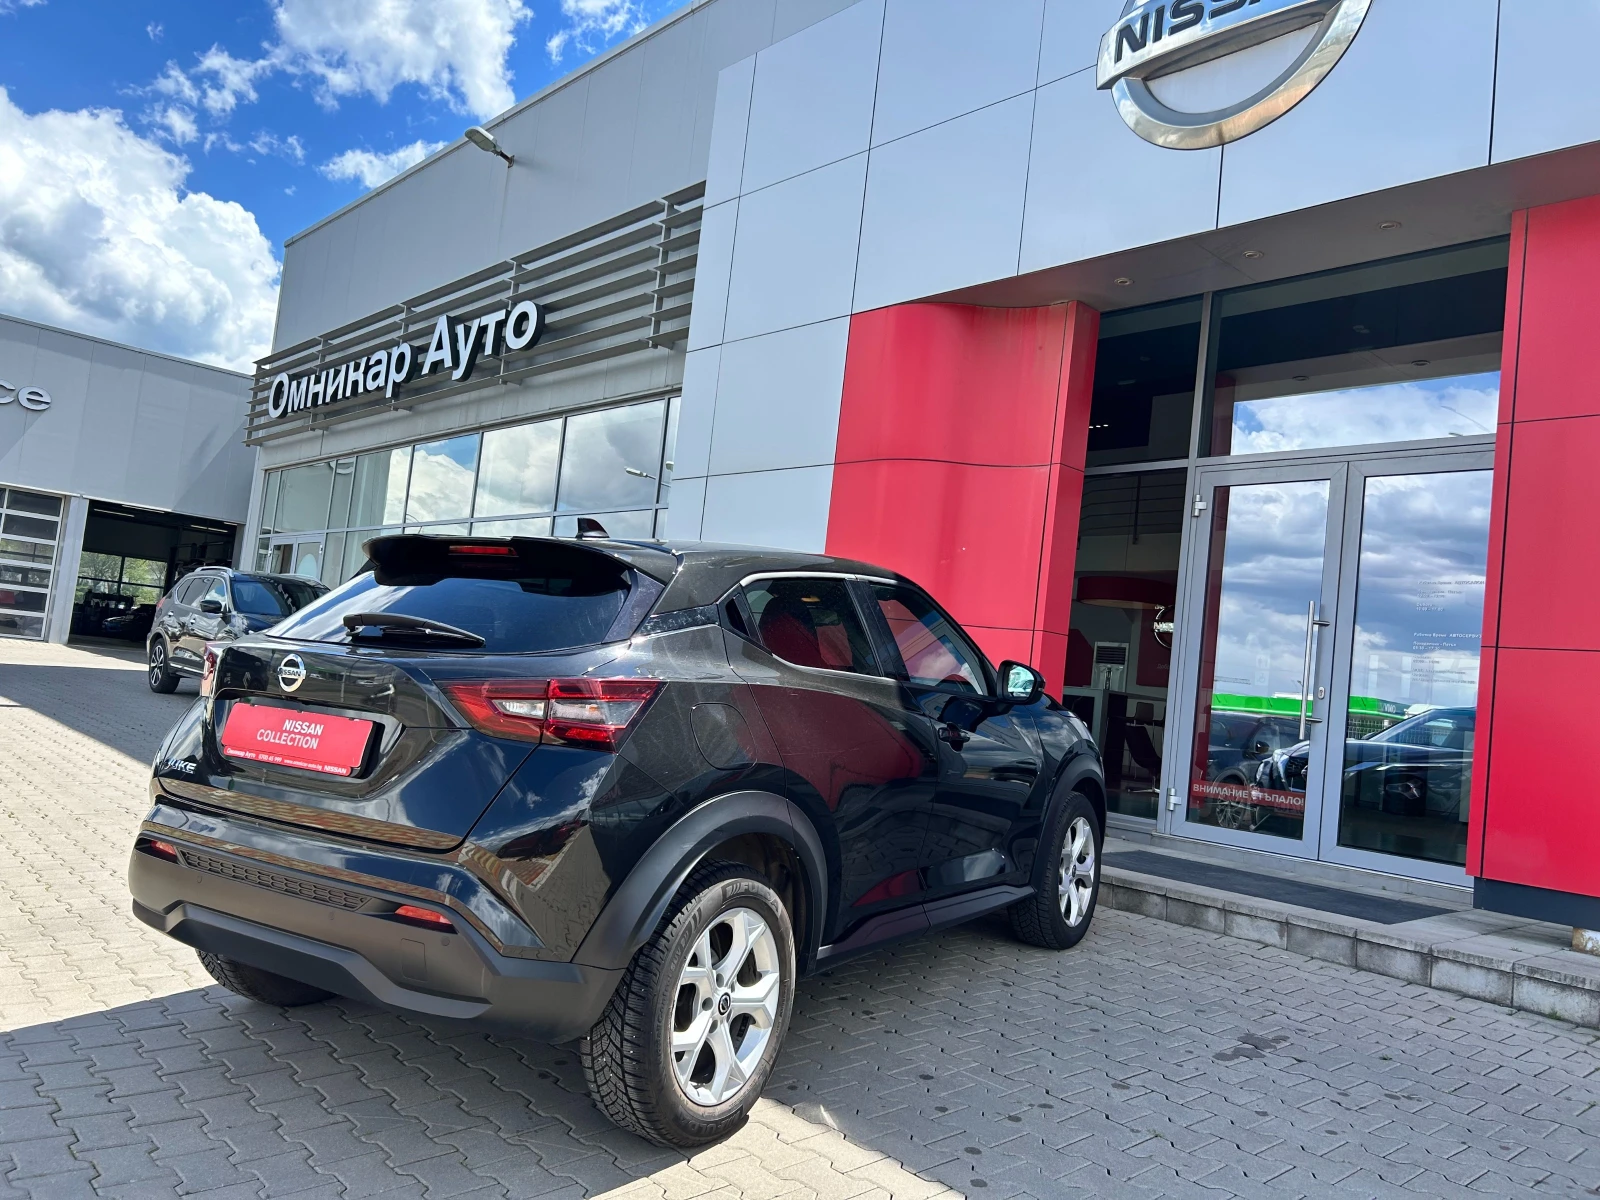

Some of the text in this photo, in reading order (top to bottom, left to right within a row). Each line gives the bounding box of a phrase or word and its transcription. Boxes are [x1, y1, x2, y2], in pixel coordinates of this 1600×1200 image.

[268, 300, 538, 419] Омникар Ауто
[283, 719, 324, 736] NISSAN
[256, 729, 319, 750] COLLECTION
[164, 759, 198, 775] JUKE
[245, 751, 256, 759] Ауто
[324, 765, 347, 774] NISSAN
[1193, 783, 1249, 799] ВНИМАНИЕ
